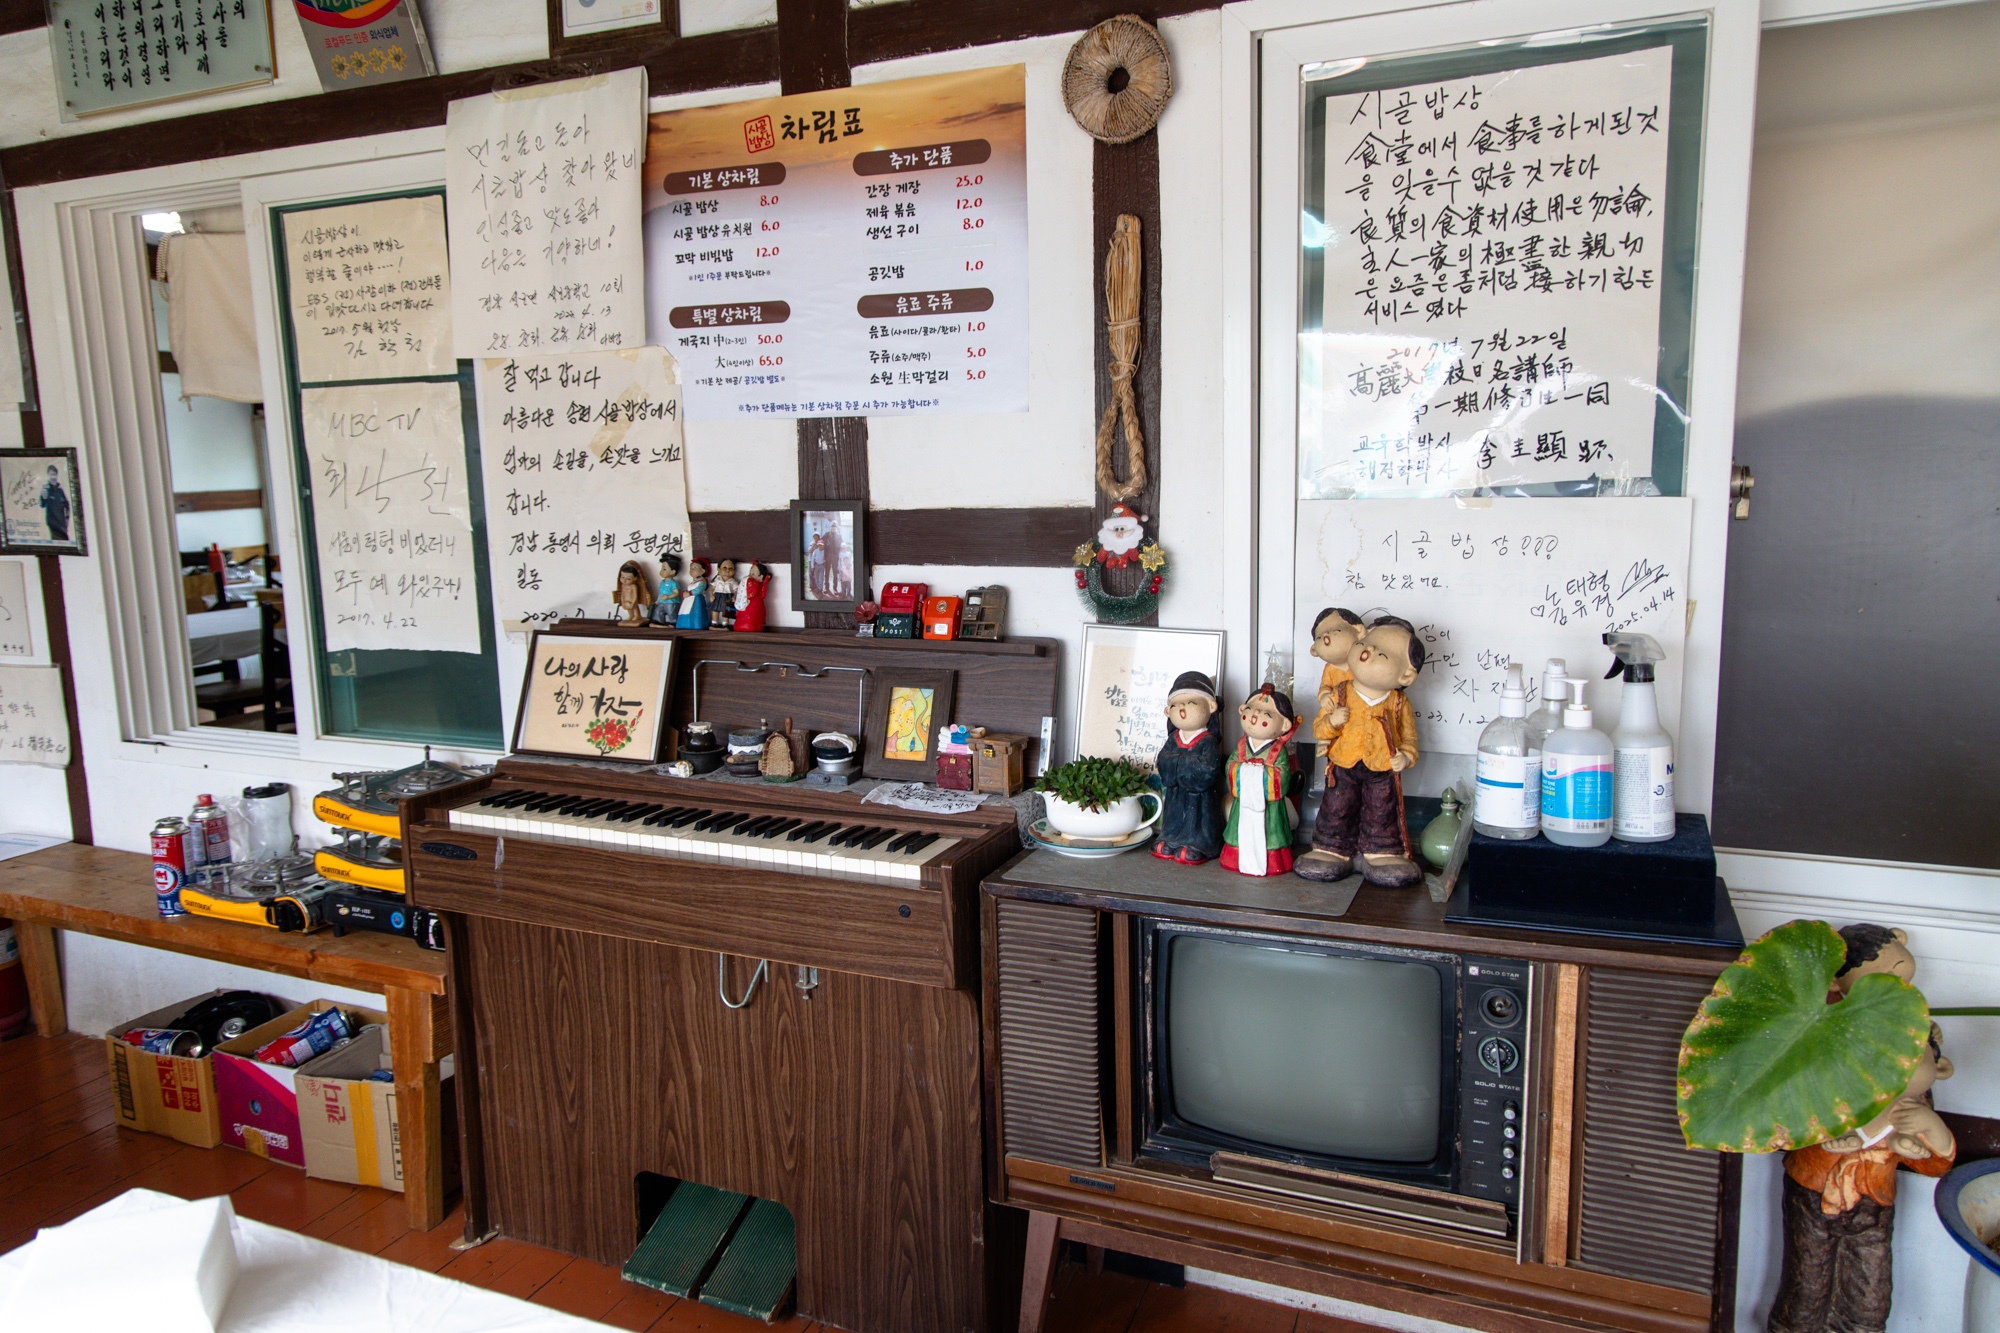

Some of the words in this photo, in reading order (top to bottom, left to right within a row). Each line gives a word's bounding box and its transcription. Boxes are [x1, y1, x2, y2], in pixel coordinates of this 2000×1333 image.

[171, 0, 189, 55] 기라
[193, 0, 211, 75] 호와께
[324, 34, 353, 48] 로컬푸드
[353, 31, 369, 44] 인증
[369, 26, 399, 41] 외식업체
[1349, 84, 1482, 130] 시골밥상
[781, 107, 864, 144] 차림표
[889, 152, 919, 170] 추가
[922, 145, 953, 167] 단품
[1550, 153, 1600, 180] 같다
[689, 171, 713, 189] 기본
[717, 168, 760, 187] 상차림
[865, 183, 891, 199] 간장
[895, 180, 921, 195] 게장
[956, 175, 984, 188] 25.0
[672, 201, 692, 216] 시골
[695, 199, 719, 214] 밥상
[760, 195, 779, 207] 8.0
[866, 204, 889, 220] 제육
[894, 202, 916, 218] 볶음
[956, 197, 983, 210] 12.0
[673, 226, 693, 241] 시골
[761, 220, 780, 232] 6.0
[866, 225, 892, 240] 생선
[896, 223, 919, 238] 구이
[962, 217, 984, 230] 8.0
[675, 252, 696, 264] 꼬막
[700, 248, 734, 263] 비빔밥
[756, 246, 780, 258] 12.0
[868, 264, 905, 282] 공깃밥
[965, 260, 984, 272] 1.0
[1355, 277, 1379, 299] 은
[896, 296, 921, 314] 음료
[926, 293, 954, 311] 주류
[1364, 298, 1420, 326] 서비스
[692, 308, 718, 325] 특별
[720, 306, 762, 323] 상차림
[967, 321, 986, 332] 1.0
[678, 334, 710, 349] 게국지
[757, 334, 783, 345] 50.0
[966, 347, 987, 358] 5.0
[758, 355, 784, 367] 65.0
[503, 359, 520, 392] 잘
[524, 364, 552, 390] 먹고
[557, 361, 602, 389] 갑니다
[870, 371, 893, 385] 소원
[966, 369, 987, 381] 5.0
[800, 402, 816, 412] 기본
[817, 401, 843, 412] 상차림
[844, 401, 860, 411] 주문
[862, 400, 870, 409] 시
[873, 399, 889, 409] 추가
[327, 411, 381, 438] MBC
[386, 407, 421, 431] TV
[502, 406, 555, 433] 아름다운
[503, 445, 541, 475] 엄마의
[508, 530, 540, 556] 경남
[542, 529, 580, 555] 통영시
[586, 529, 616, 555] 의회
[516, 562, 543, 591] 일동
[544, 656, 580, 678] 나의
[582, 653, 629, 684] 사랑
[553, 681, 584, 715] 함께
[590, 687, 643, 718] 가자
[1475, 1080, 1496, 1088] SOLID
[1499, 1084, 1520, 1092] STATE
[322, 1083, 346, 1125] 캔디
